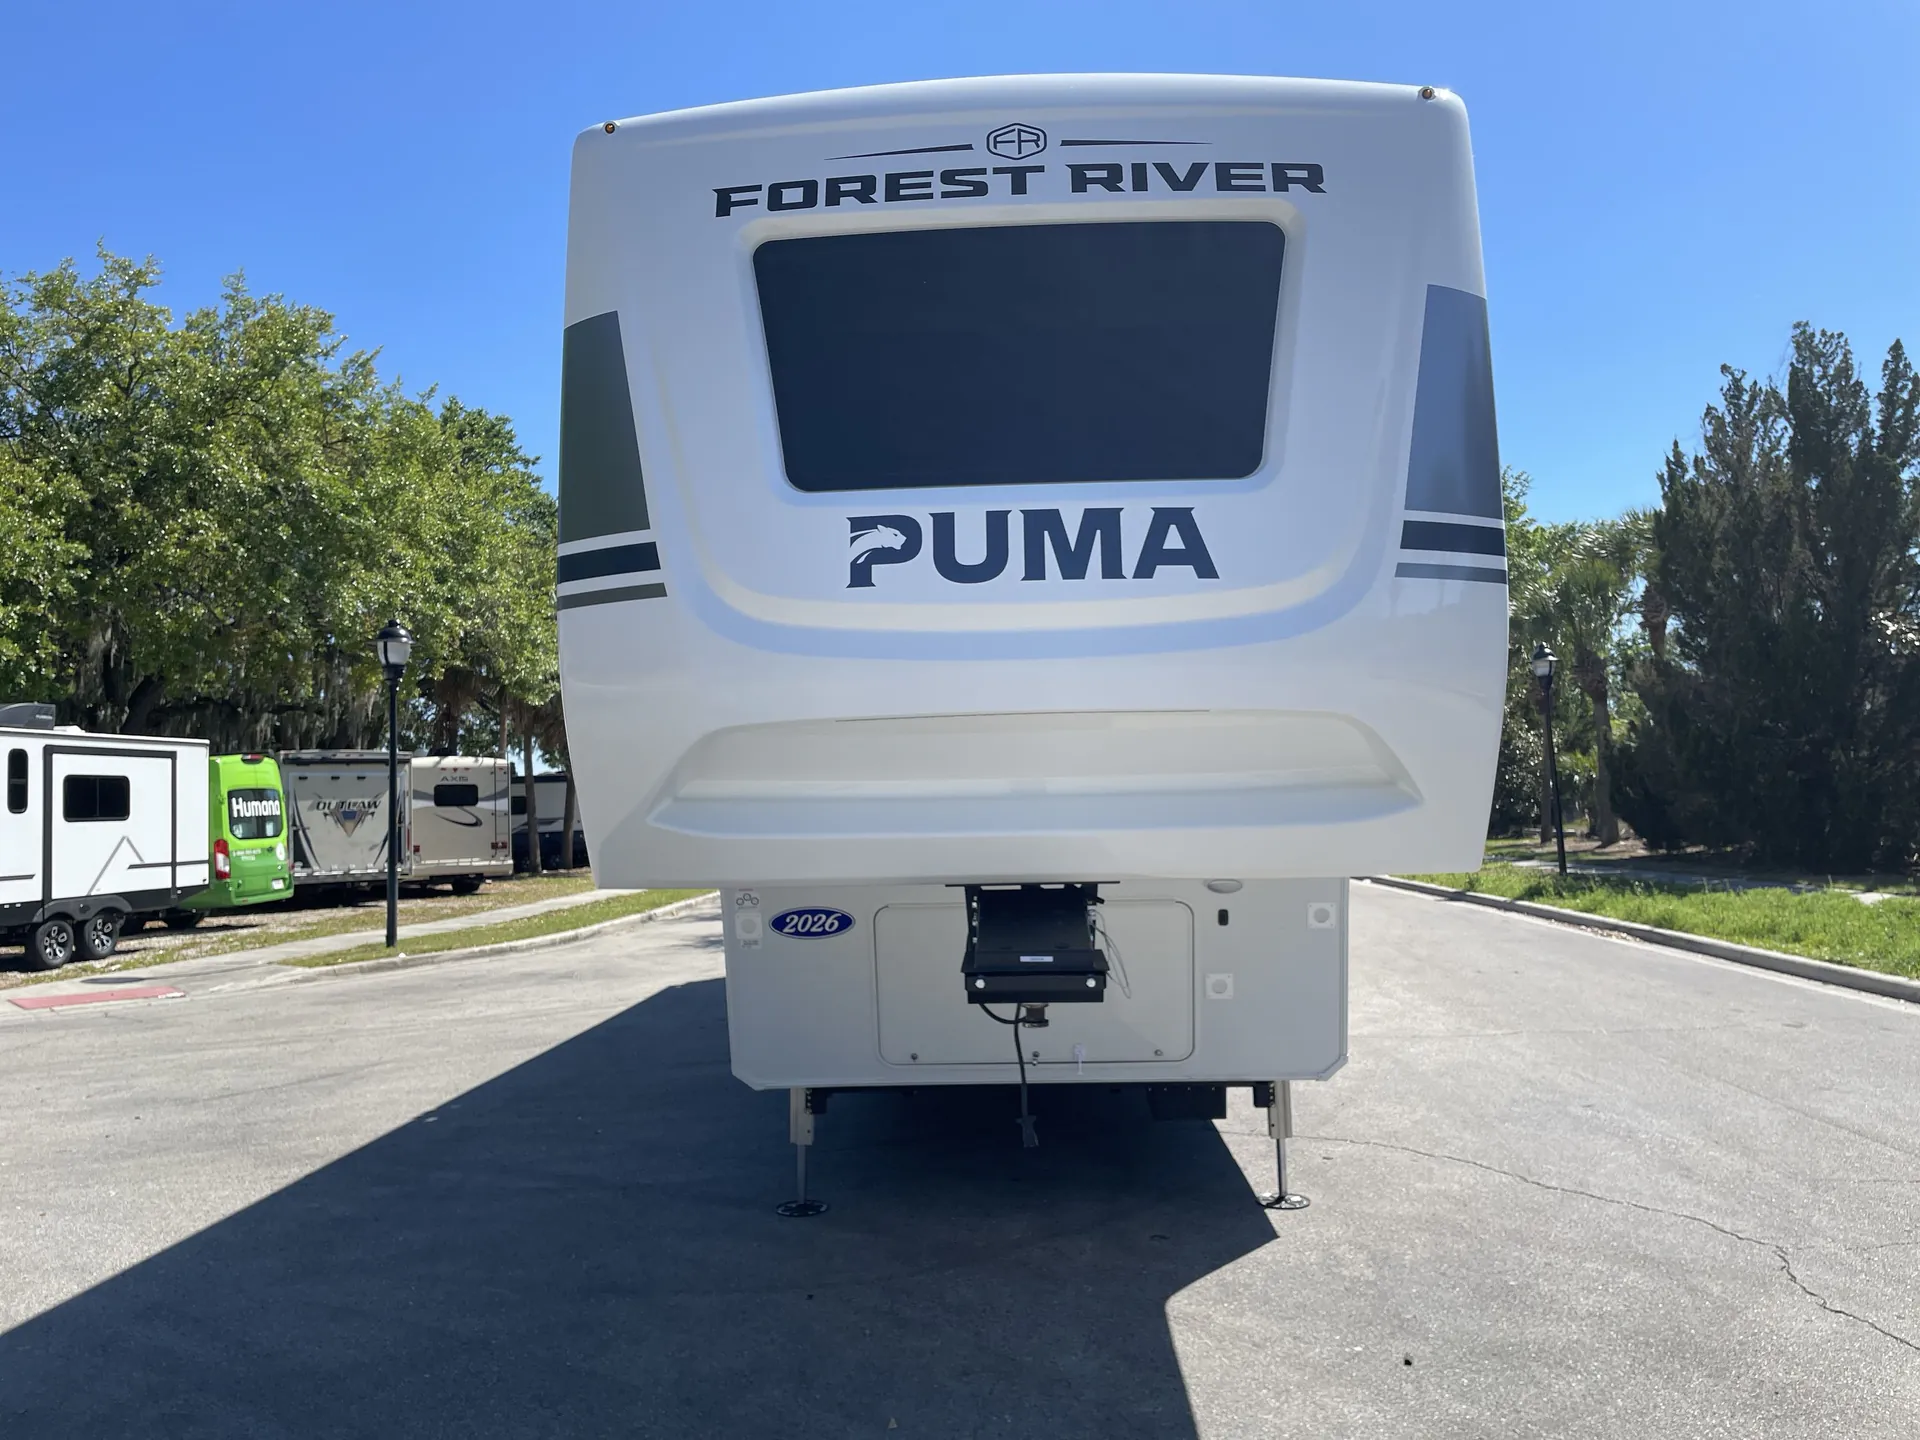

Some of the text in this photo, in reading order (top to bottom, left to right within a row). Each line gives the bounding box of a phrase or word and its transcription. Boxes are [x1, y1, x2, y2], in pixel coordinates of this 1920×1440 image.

[993, 127, 1041, 155] FR
[711, 161, 1328, 218] FOREST RIVER
[845, 506, 1221, 589] PUMA
[440, 775, 469, 783] AXIS
[231, 797, 281, 818] Humana
[315, 799, 382, 812] OUTLAW
[782, 913, 842, 933] 2026
